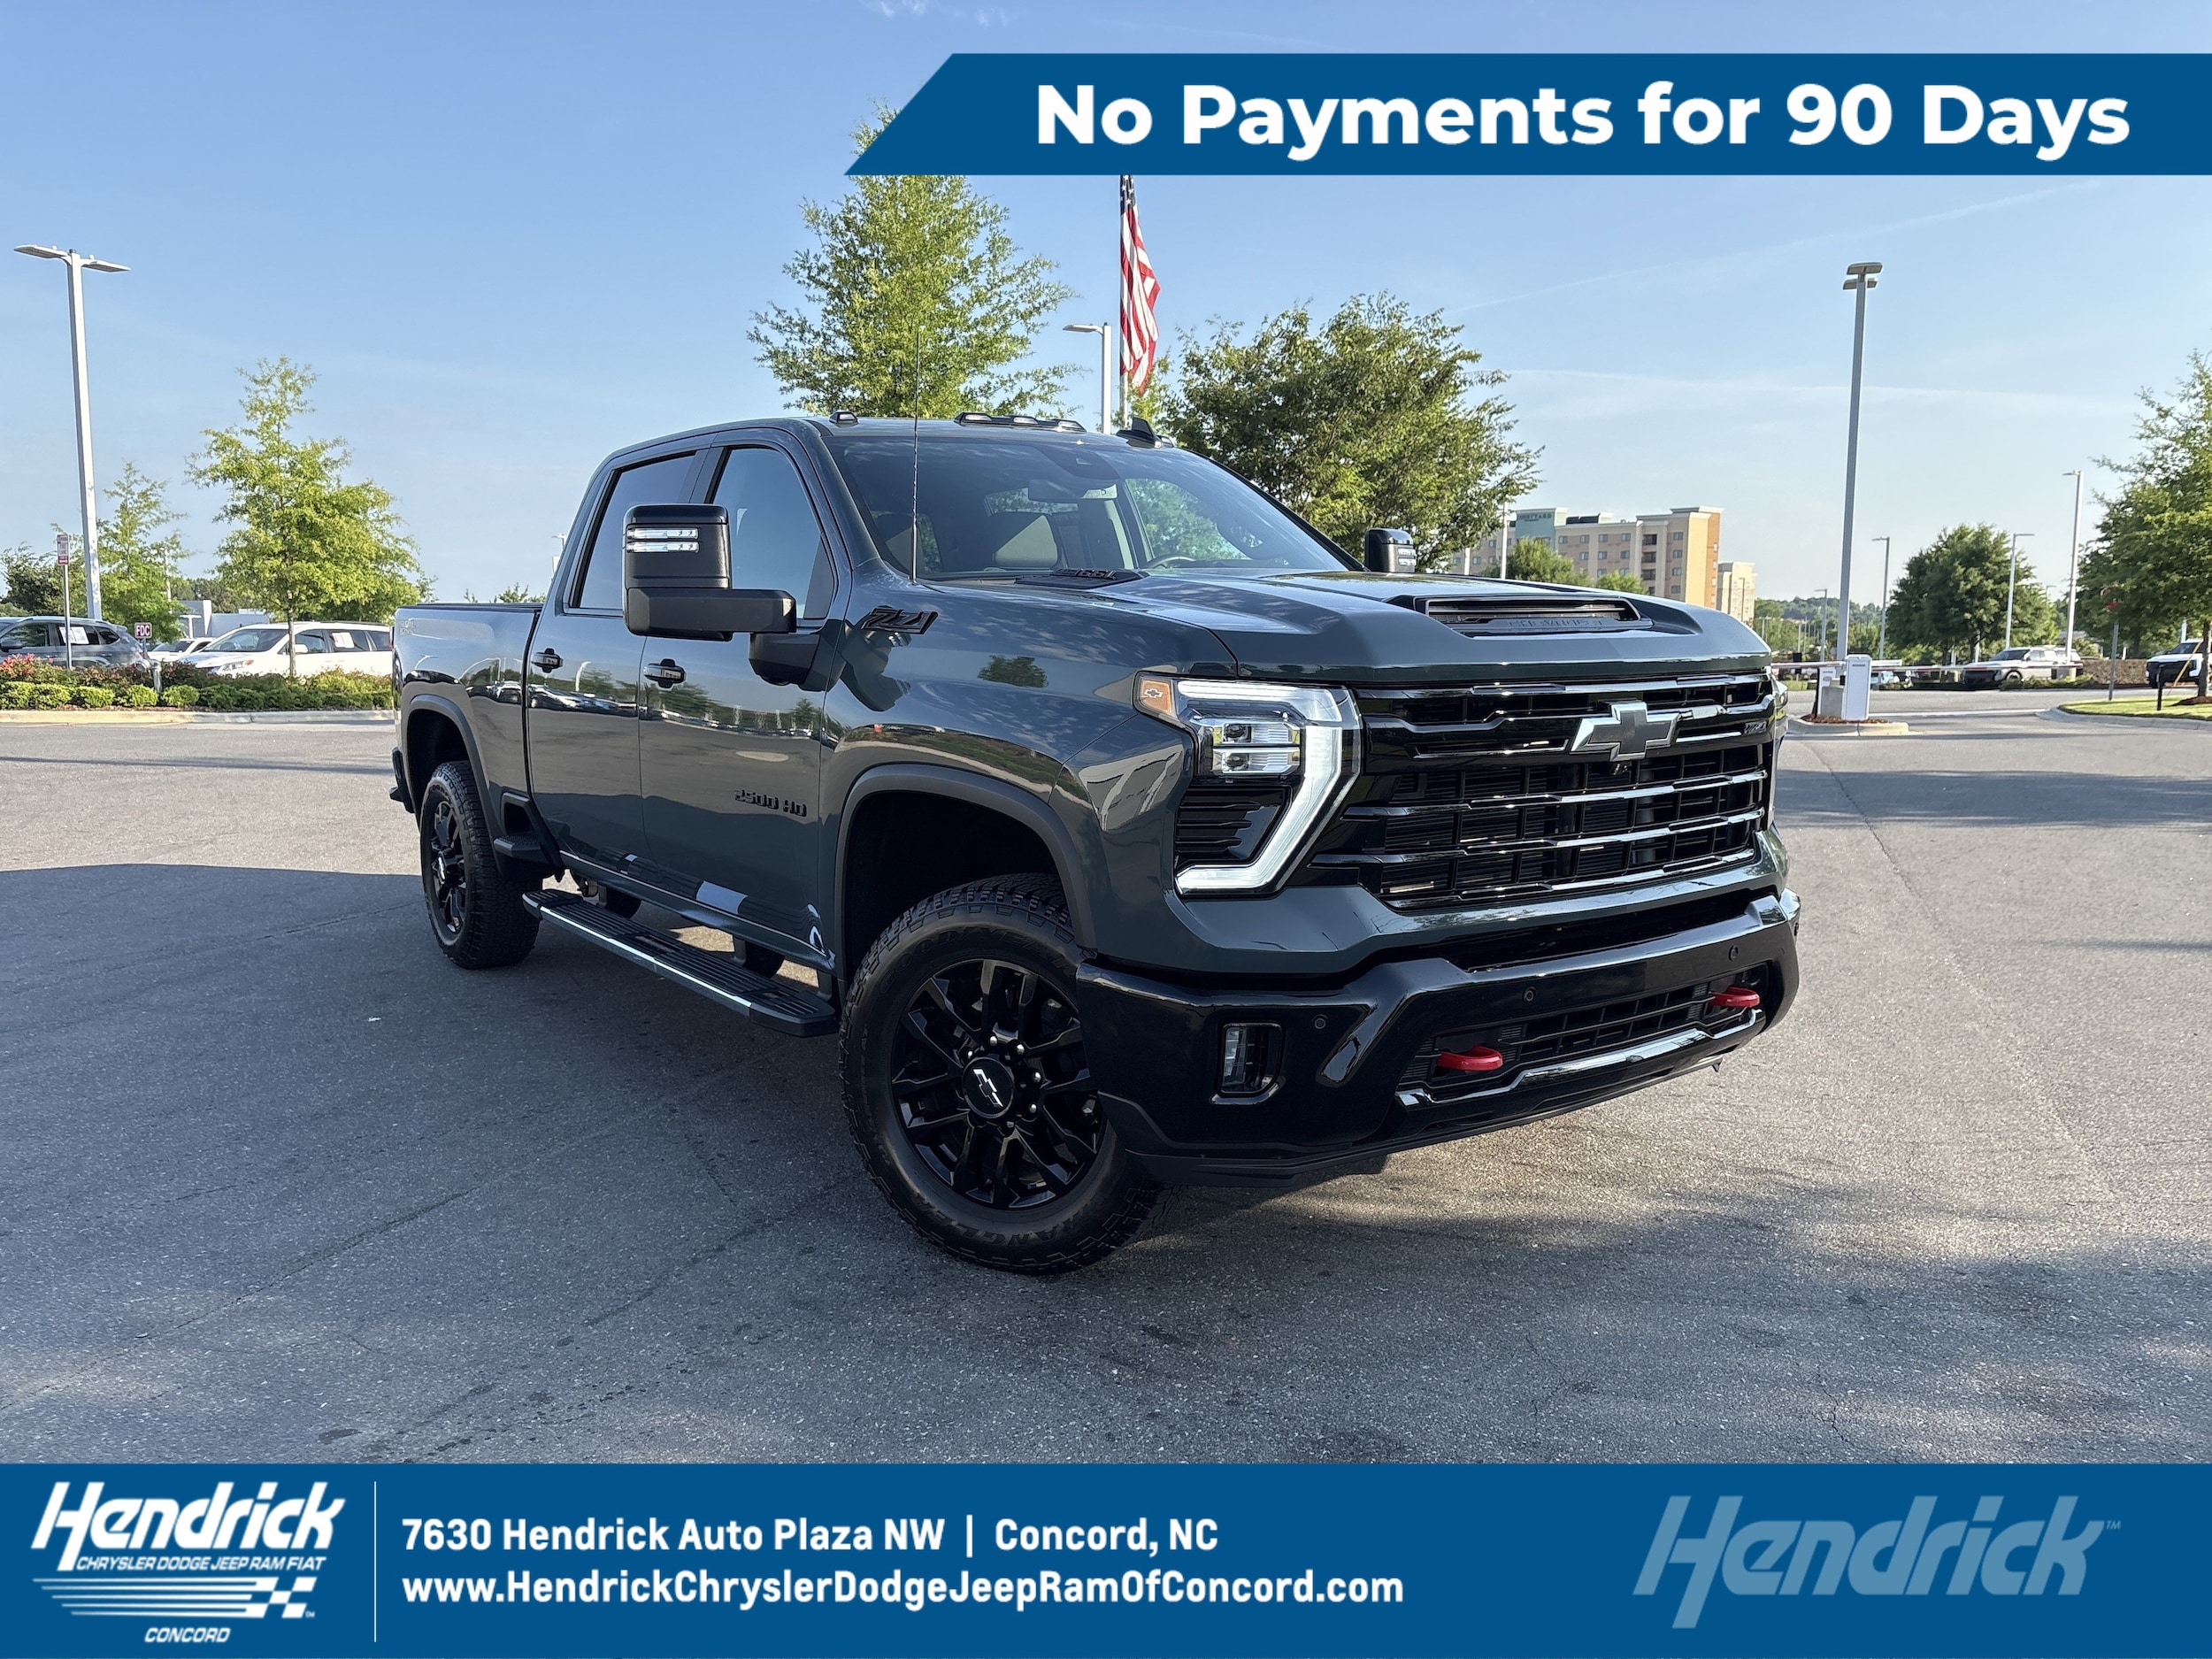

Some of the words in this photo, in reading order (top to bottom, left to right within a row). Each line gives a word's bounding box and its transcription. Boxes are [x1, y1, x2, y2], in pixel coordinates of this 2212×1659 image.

[135, 625, 150, 636] FDC
[734, 788, 780, 810] 2500
[783, 799, 807, 818] HD
